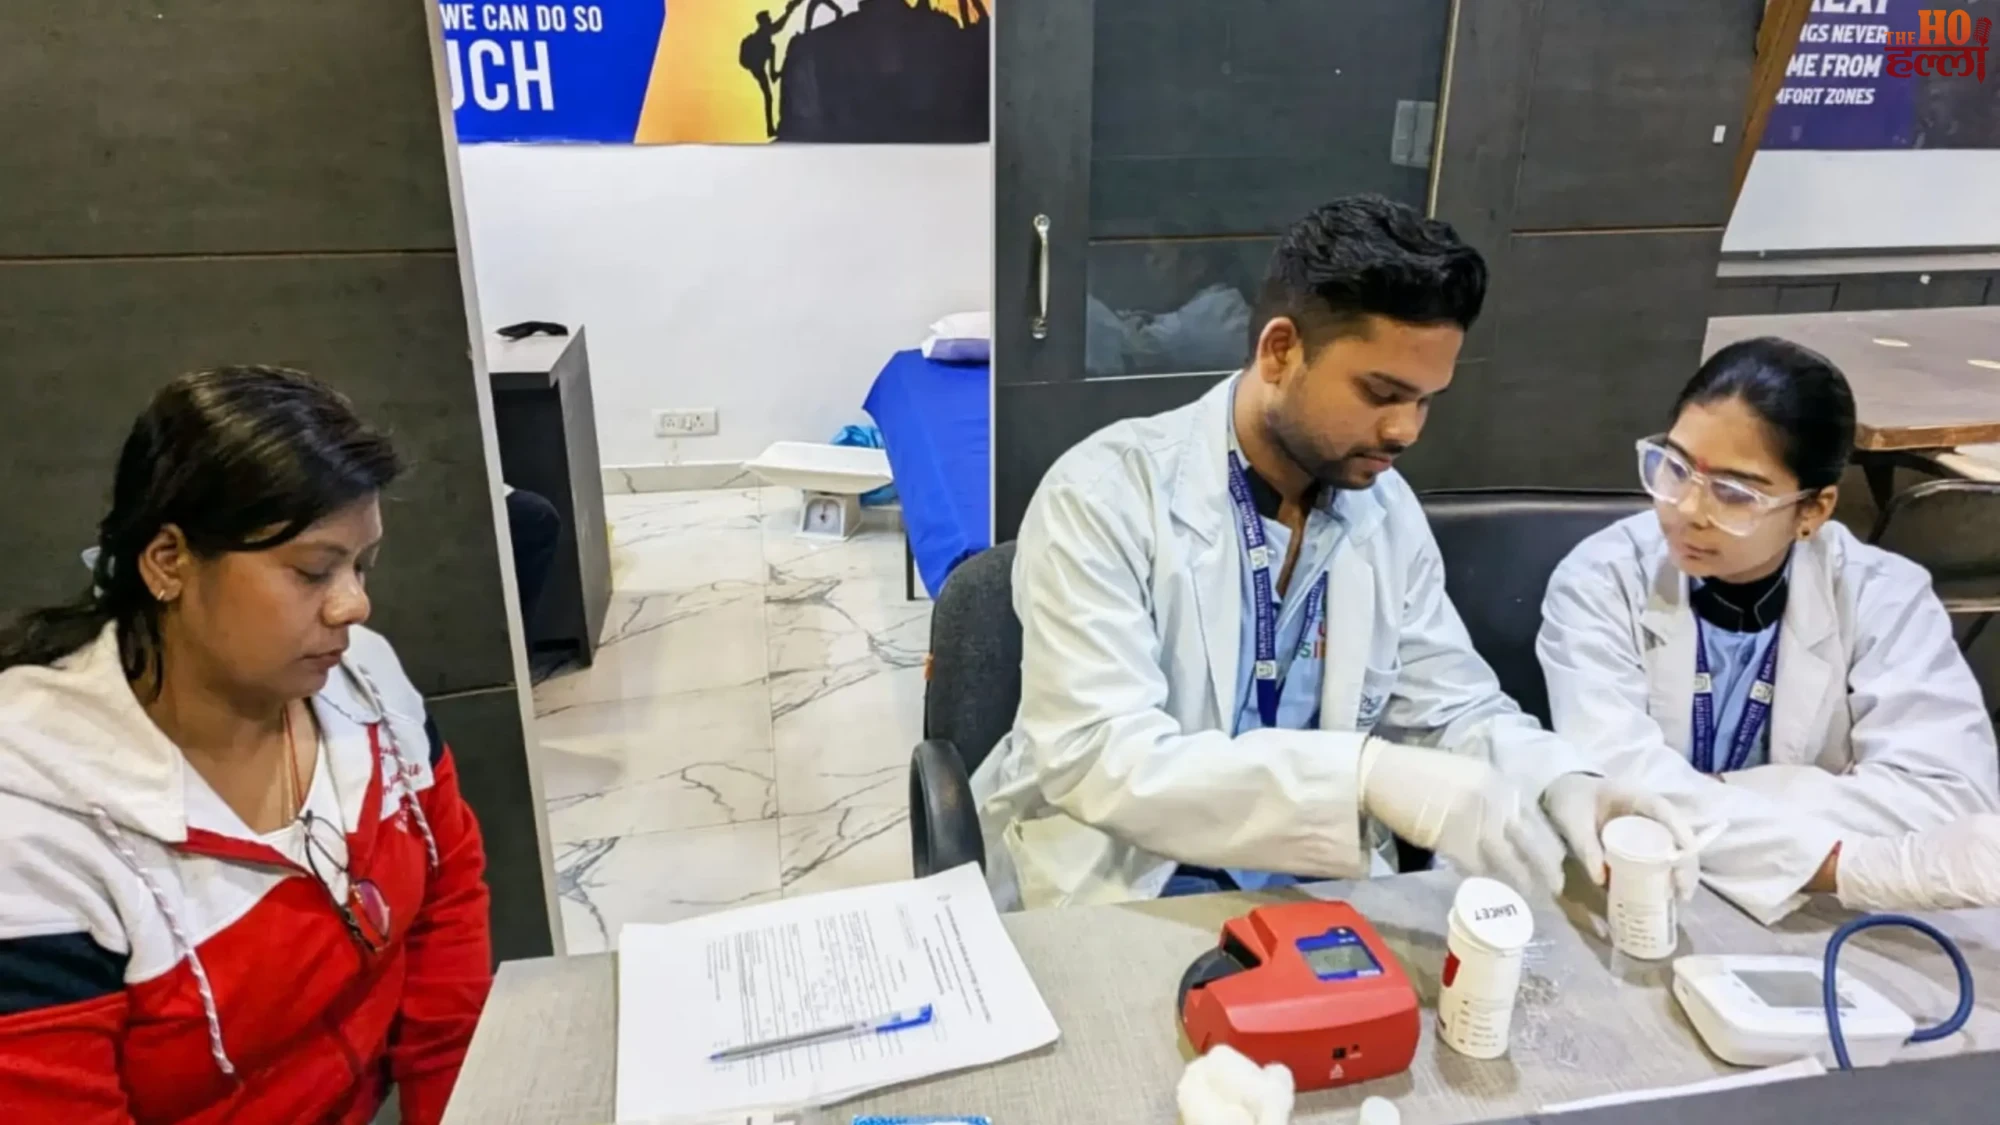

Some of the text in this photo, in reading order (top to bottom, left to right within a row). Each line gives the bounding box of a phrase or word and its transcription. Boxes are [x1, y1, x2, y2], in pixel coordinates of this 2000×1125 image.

[439, 3, 603, 32] WE CAN DO SO
[1831, 24, 1889, 43] NEVER
[1820, 53, 1884, 77] FROM
[1824, 87, 1876, 104] ZONES
